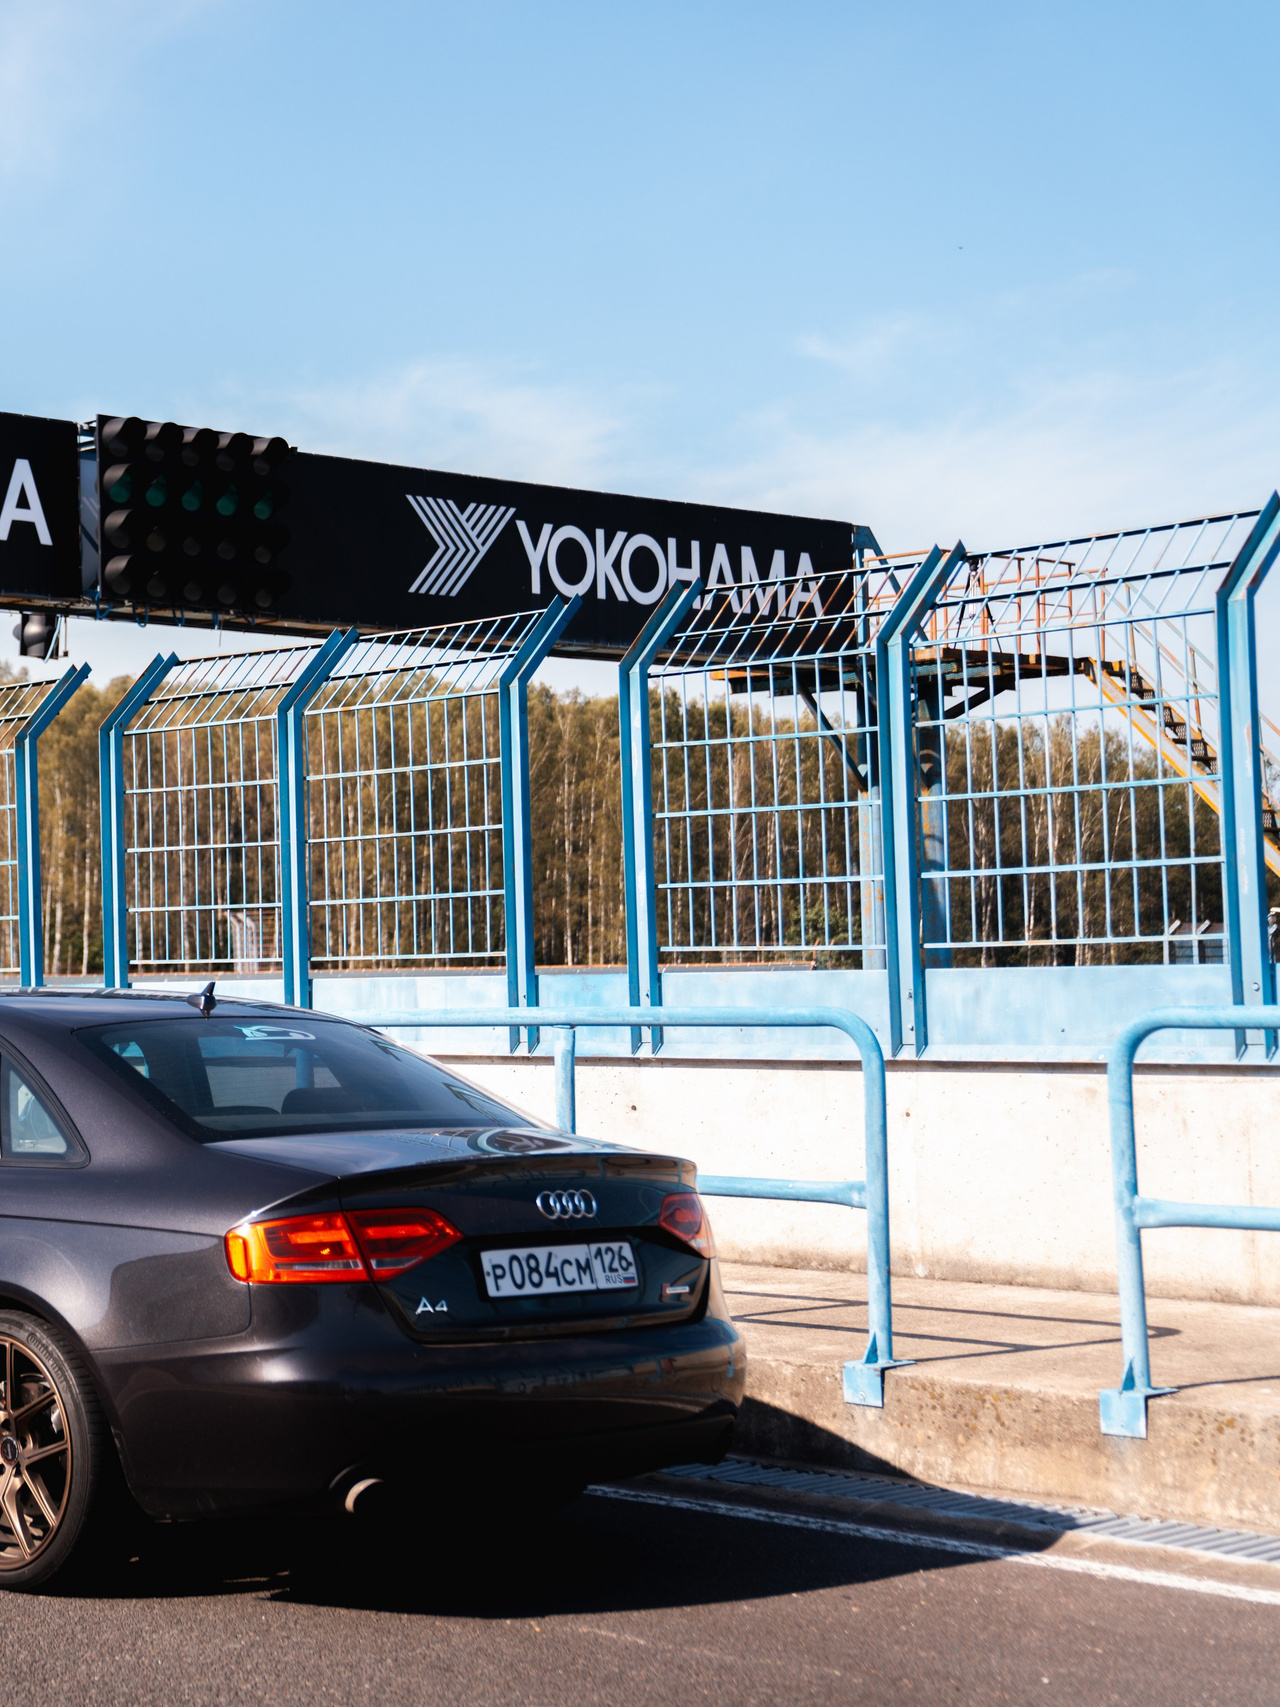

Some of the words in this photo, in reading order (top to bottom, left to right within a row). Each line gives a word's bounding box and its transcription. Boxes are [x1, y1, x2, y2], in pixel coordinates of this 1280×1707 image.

[515, 520, 825, 618] YOKOHAMA
[593, 1245, 631, 1274] 126
[604, 1274, 623, 1285] RUS
[415, 1296, 448, 1315] A4
